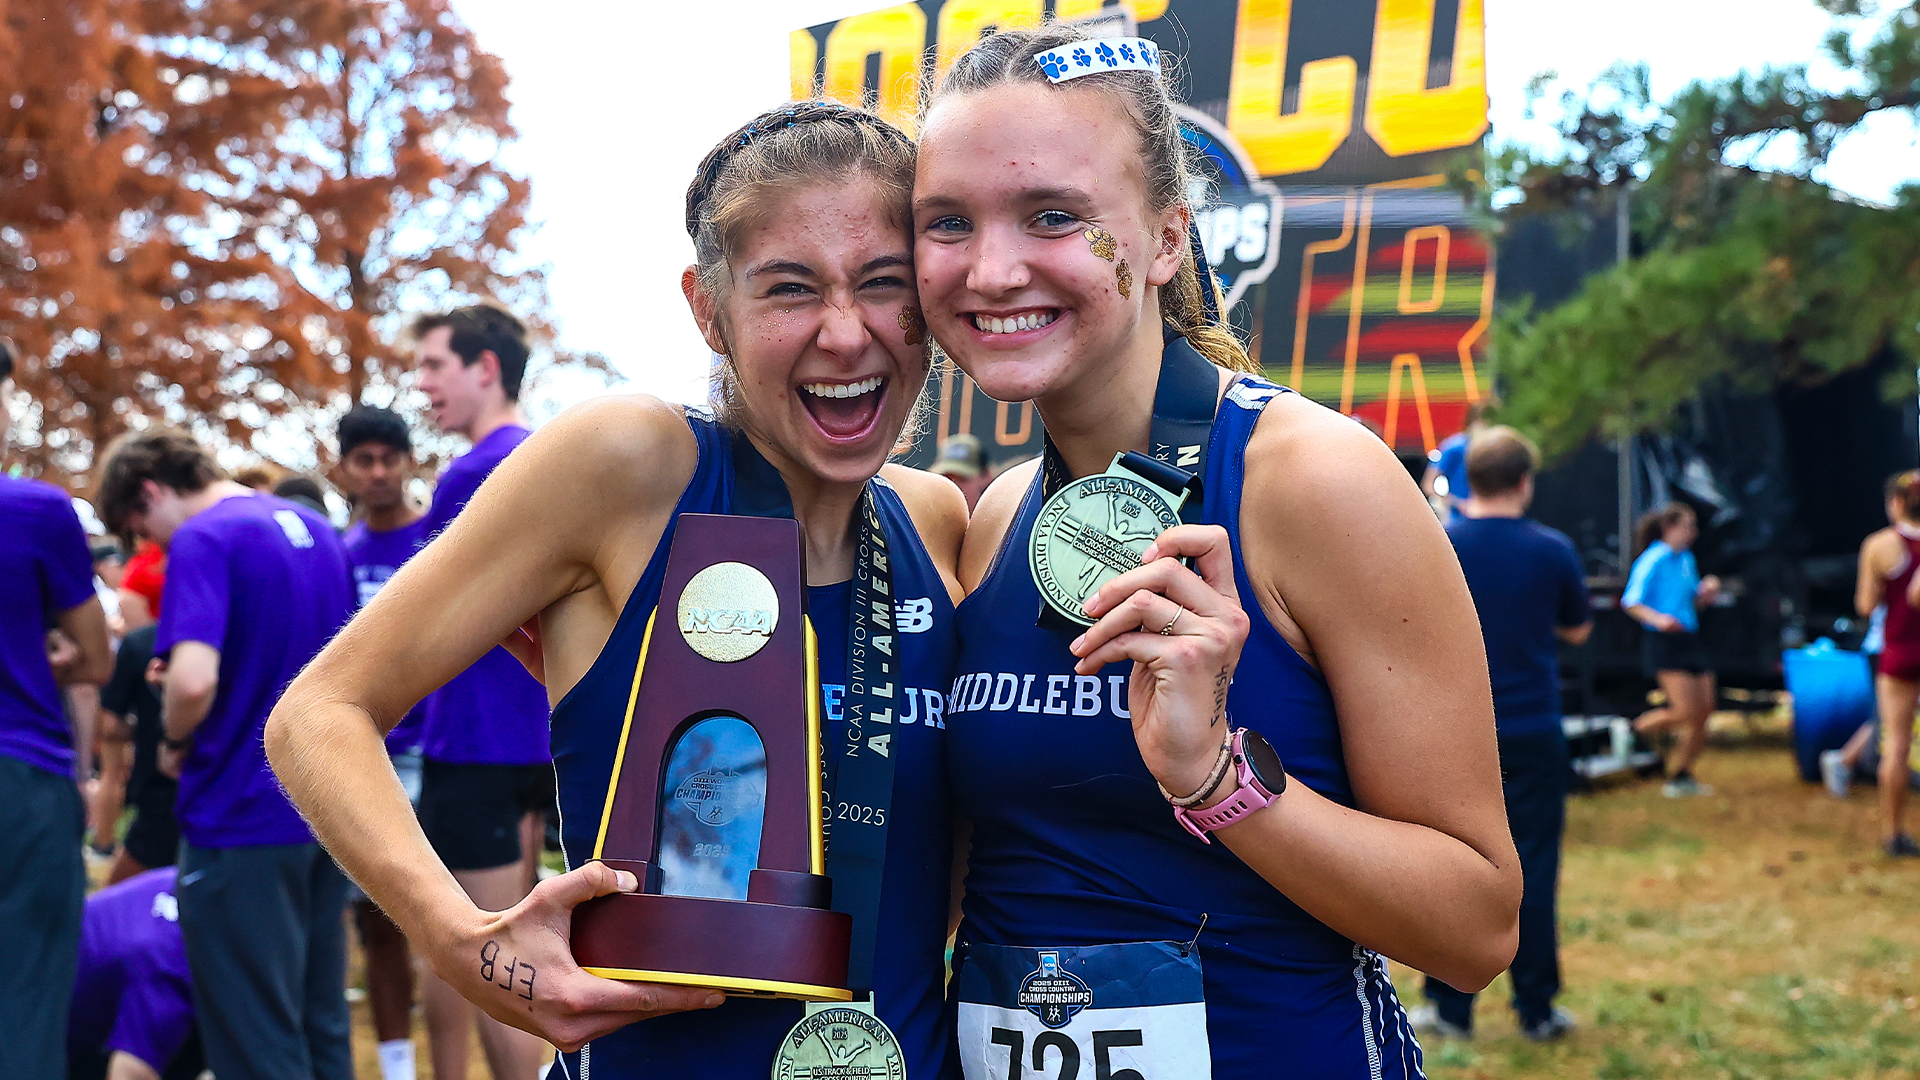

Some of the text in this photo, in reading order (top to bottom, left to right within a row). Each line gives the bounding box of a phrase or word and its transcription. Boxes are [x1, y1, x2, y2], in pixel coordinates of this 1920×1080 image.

[1038, 502, 1064, 538] NCAA
[1121, 503, 1141, 519] 2025
[858, 524, 869, 581] CROSS
[1084, 537, 1107, 554] CROSS
[1105, 549, 1138, 570] COUNTRY
[1093, 531, 1117, 550] TRACK
[1115, 544, 1123, 552] &
[1122, 547, 1142, 563] FIELD
[1036, 543, 1065, 600] DIVISION
[855, 588, 868, 607] III
[1063, 598, 1079, 613] III
[684, 608, 772, 634] NCAA
[851, 612, 868, 695] DIVISION
[946, 671, 1133, 719] MIDDLEBU
[846, 702, 864, 758] NCAA
[837, 802, 885, 826] 2025
[693, 842, 731, 857] 2025
[480, 940, 536, 1000] EFB
[1020, 992, 1090, 1004] CHAMPIONSHIPS
[792, 1011, 889, 1049] ALL-AMERICAN
[832, 1030, 848, 1040] 2025
[991, 1026, 1146, 1080] 725
[823, 1066, 844, 1075] TRACK
[845, 1067, 852, 1075] &
[852, 1066, 870, 1075] FIELD
